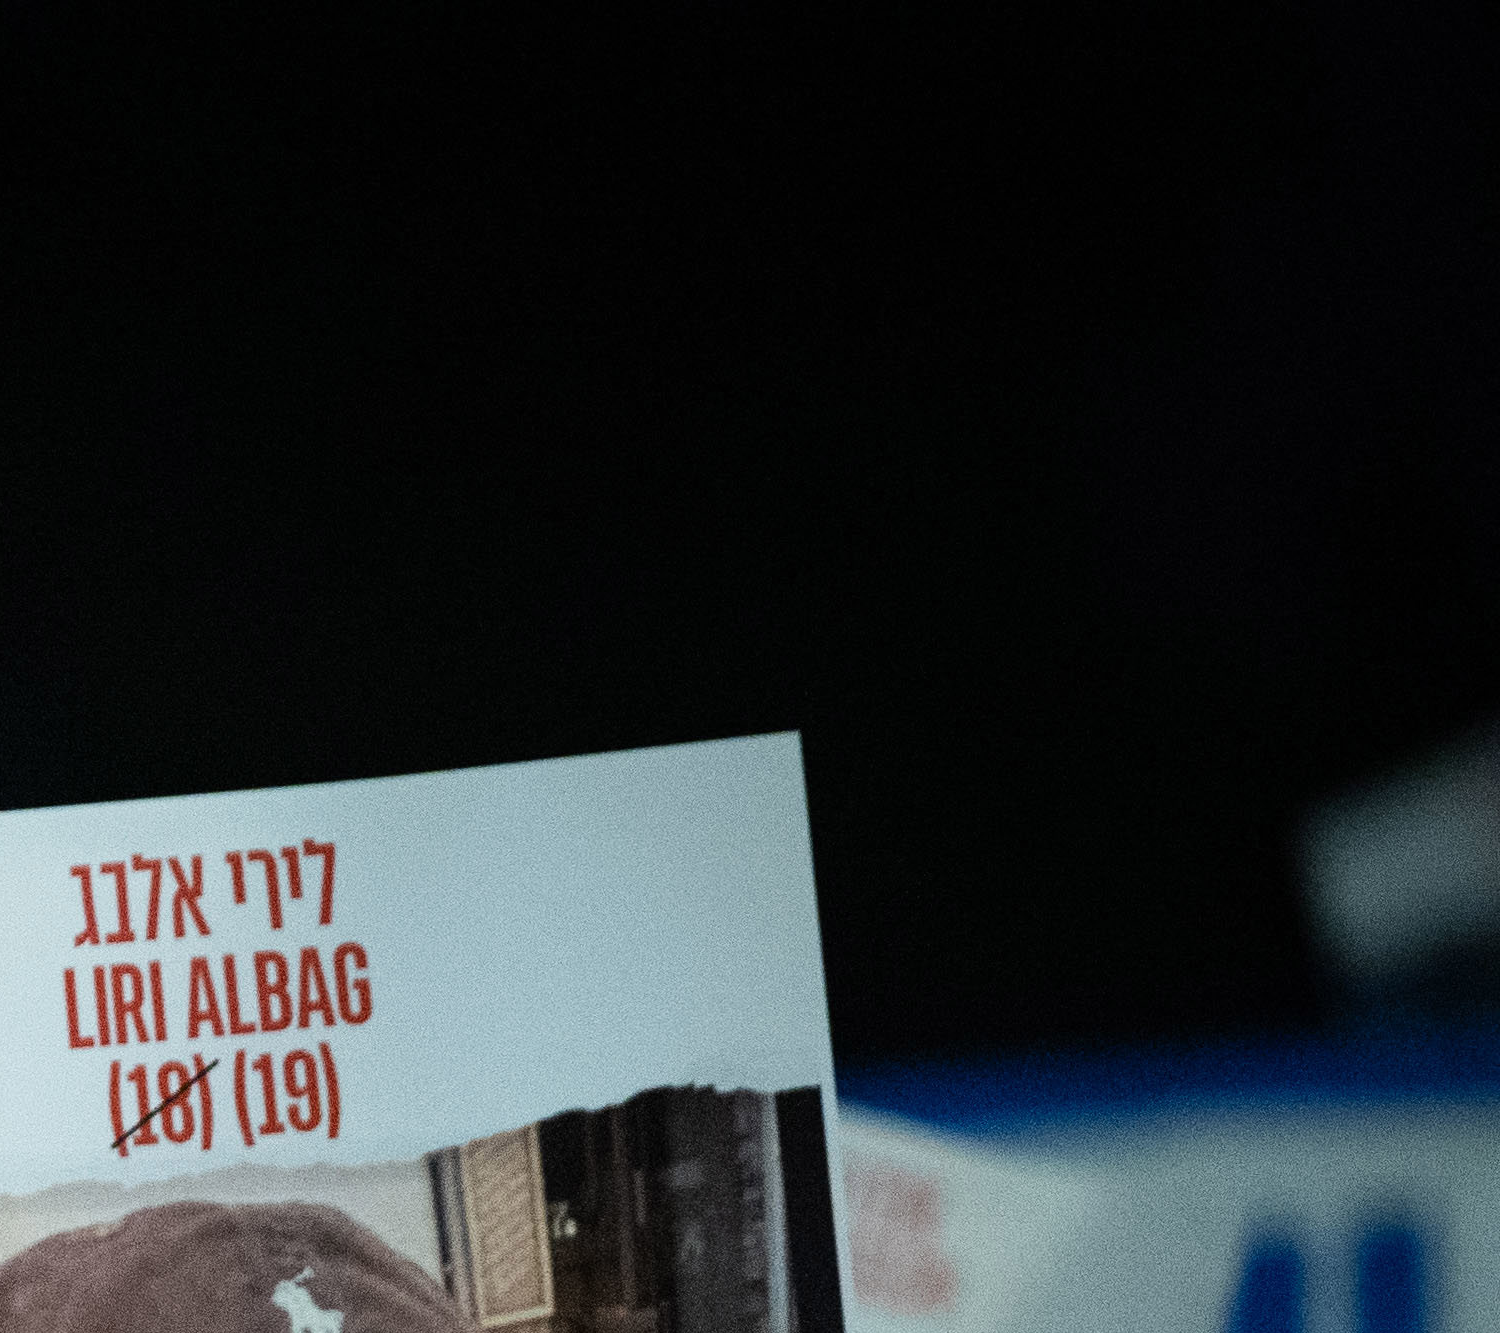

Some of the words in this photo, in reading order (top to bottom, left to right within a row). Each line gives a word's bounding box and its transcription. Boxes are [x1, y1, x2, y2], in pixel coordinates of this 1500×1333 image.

[70, 853, 212, 947] אלבג
[225, 838, 335, 931] לירי
[63, 960, 168, 1050] LIRI
[187, 941, 373, 1039] ALBAG
[233, 1042, 342, 1147] (19)
